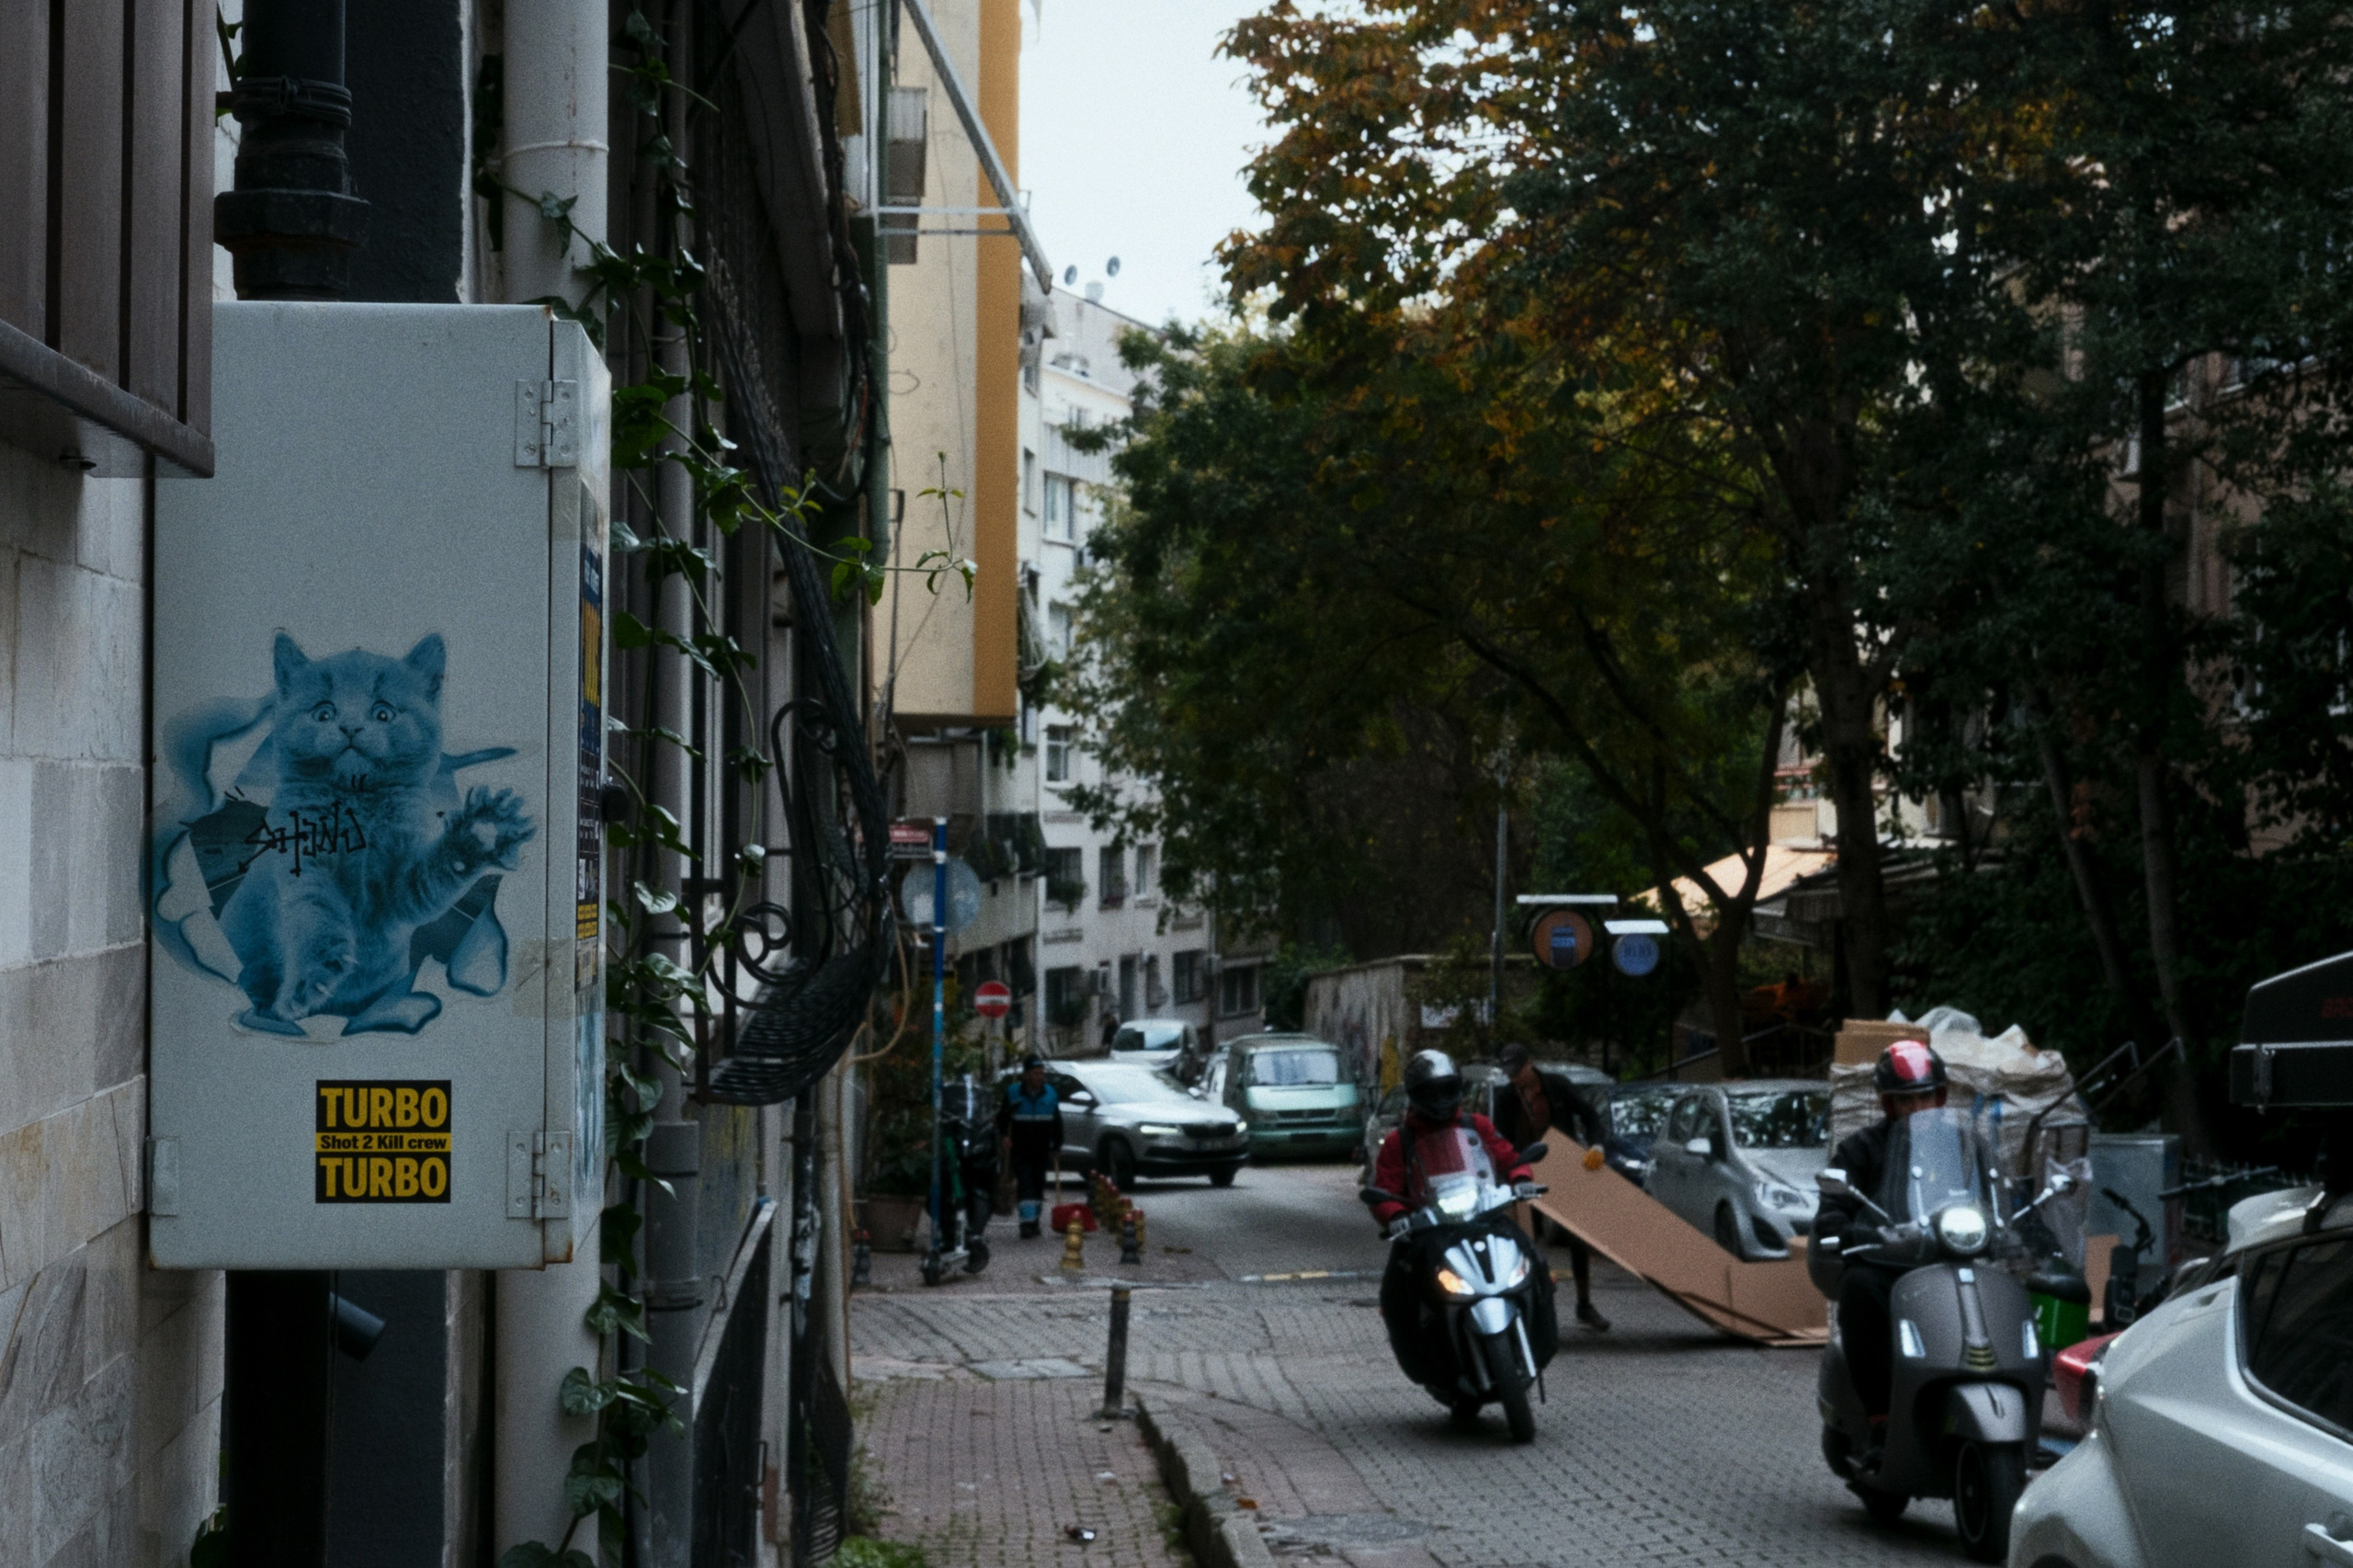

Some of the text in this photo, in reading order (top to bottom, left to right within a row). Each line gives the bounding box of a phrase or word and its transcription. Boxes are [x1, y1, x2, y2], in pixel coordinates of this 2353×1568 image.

[320, 1086, 448, 1128] TURBO
[320, 1134, 448, 1150] Shot 2 Kill crew
[319, 1156, 448, 1198] TURBO
